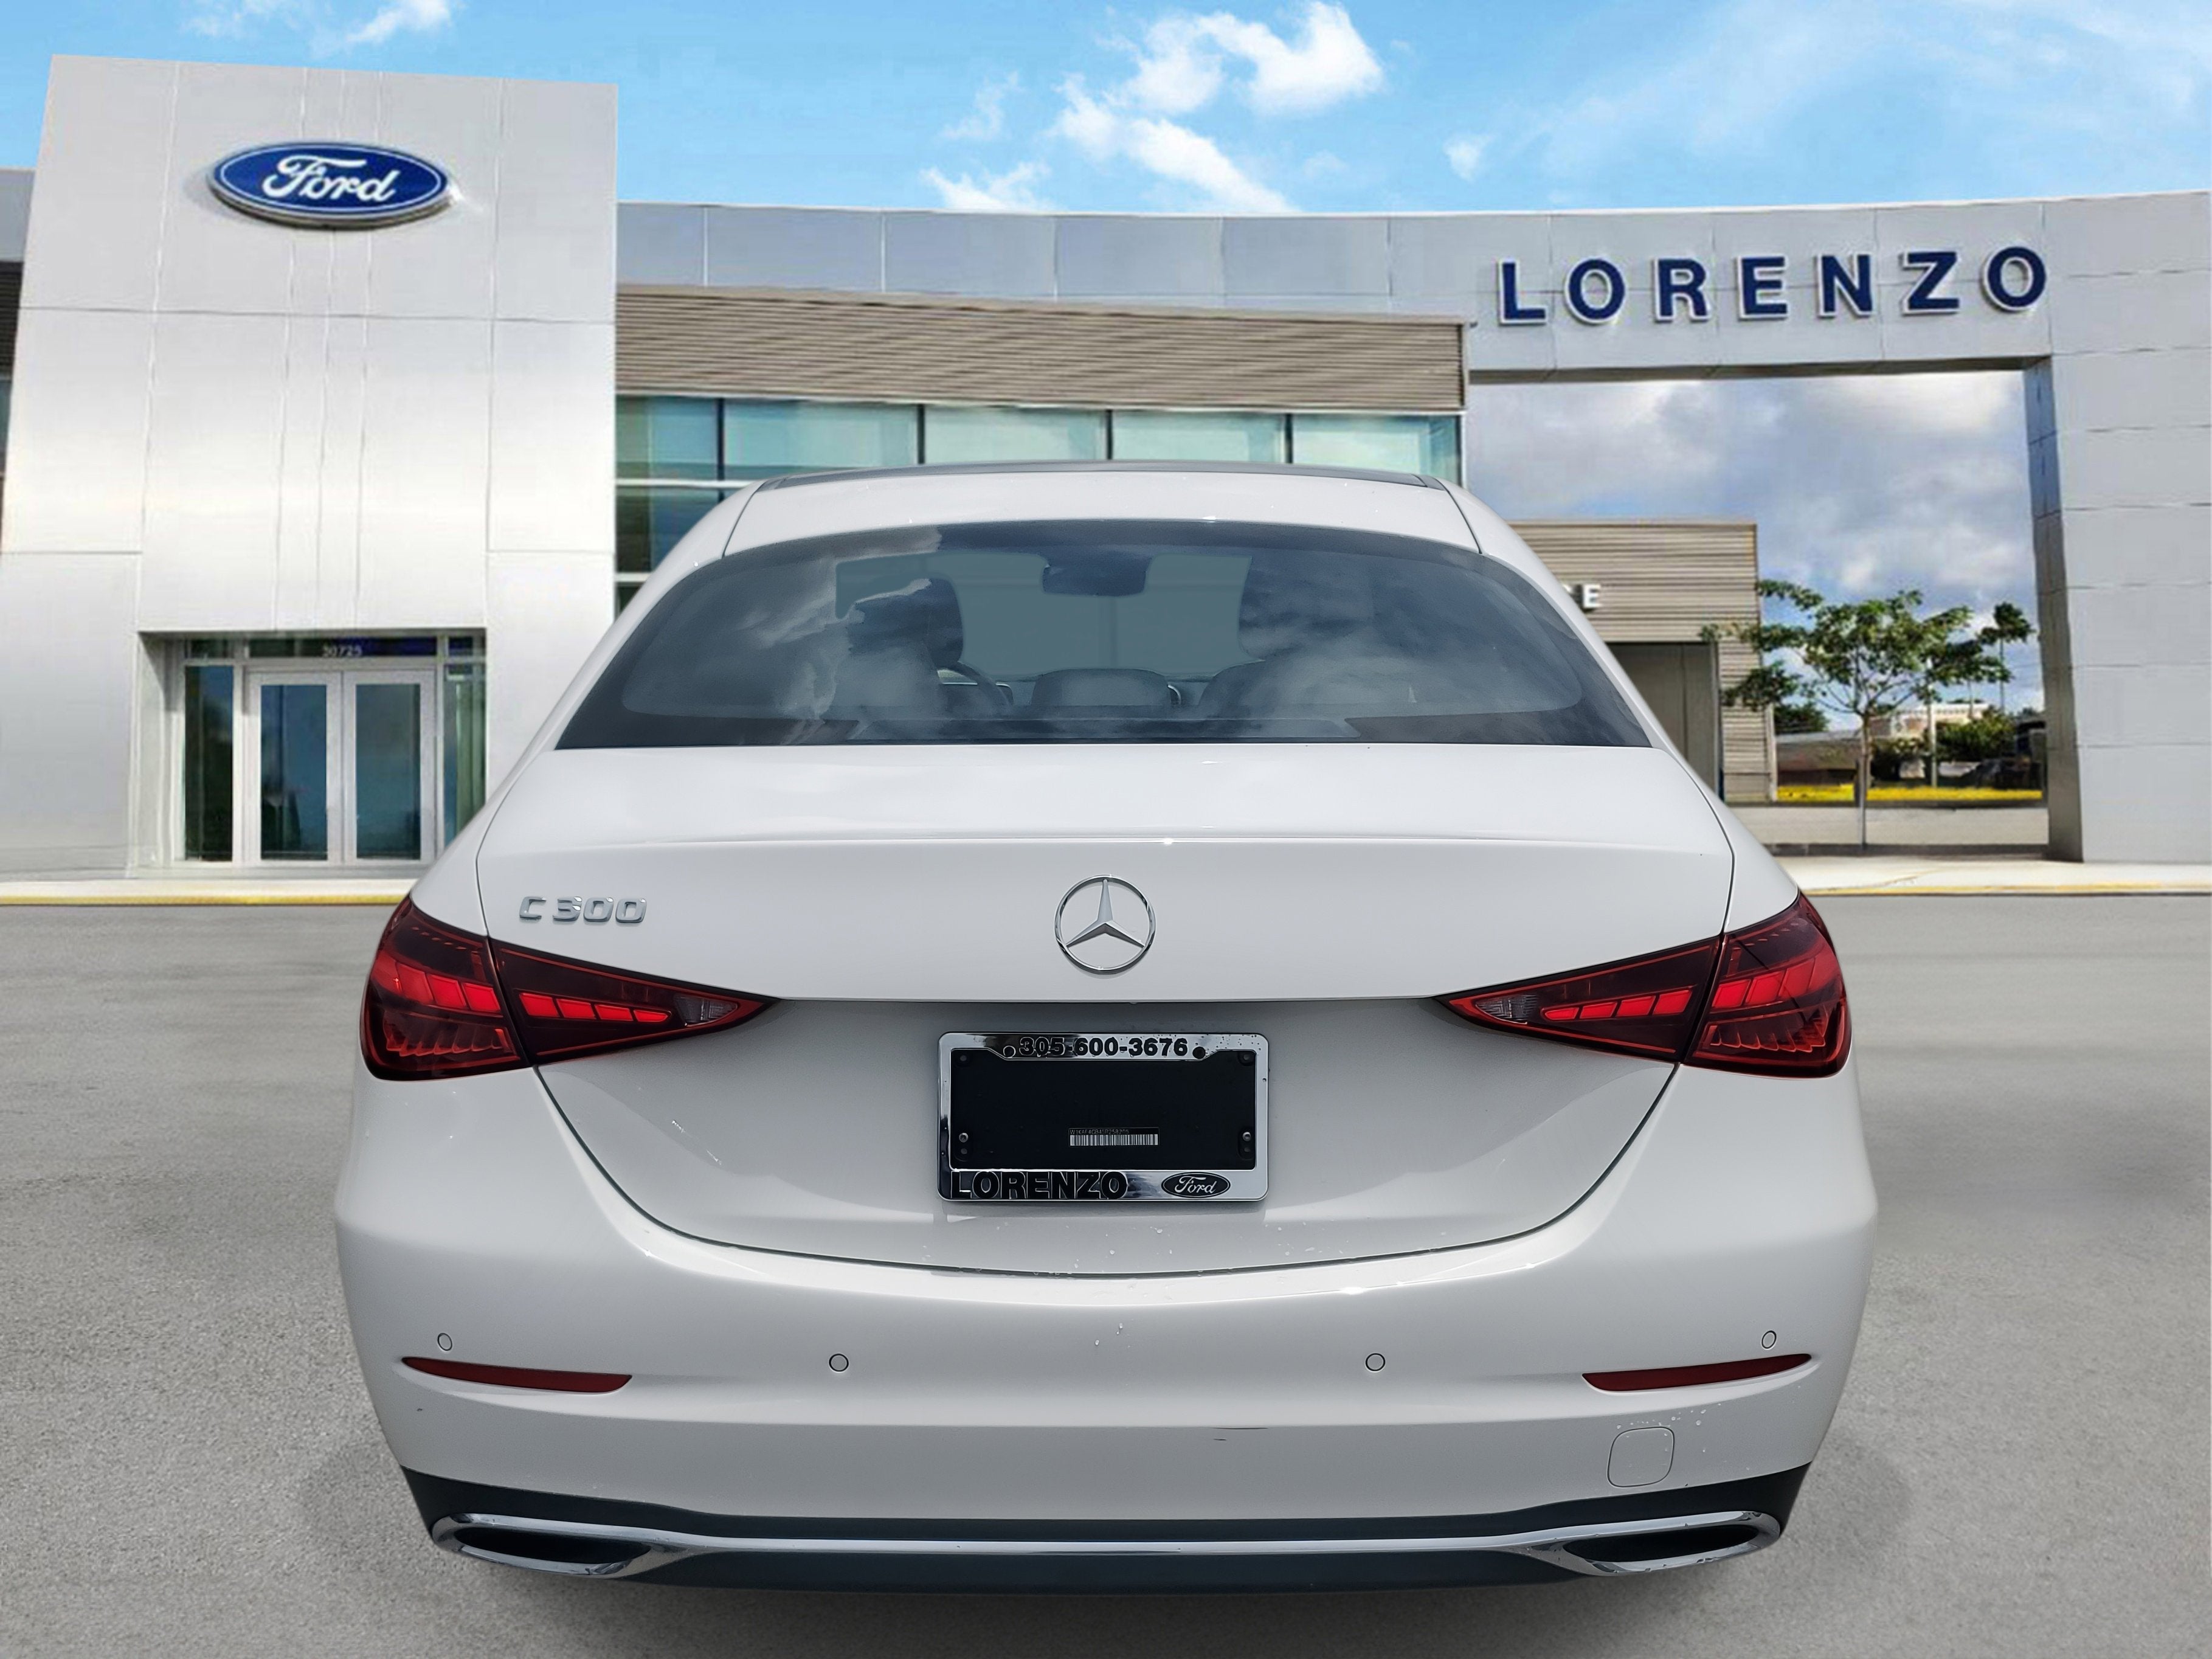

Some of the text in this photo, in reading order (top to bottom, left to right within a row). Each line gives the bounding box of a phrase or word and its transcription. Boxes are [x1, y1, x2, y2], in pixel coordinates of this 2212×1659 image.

[262, 154, 400, 201] Ford
[1498, 246, 2047, 324] LORENZO
[519, 896, 647, 923] C 300
[1019, 1036, 1188, 1058] 305-600-3676
[950, 1171, 1218, 1199] LORENZO Ford
